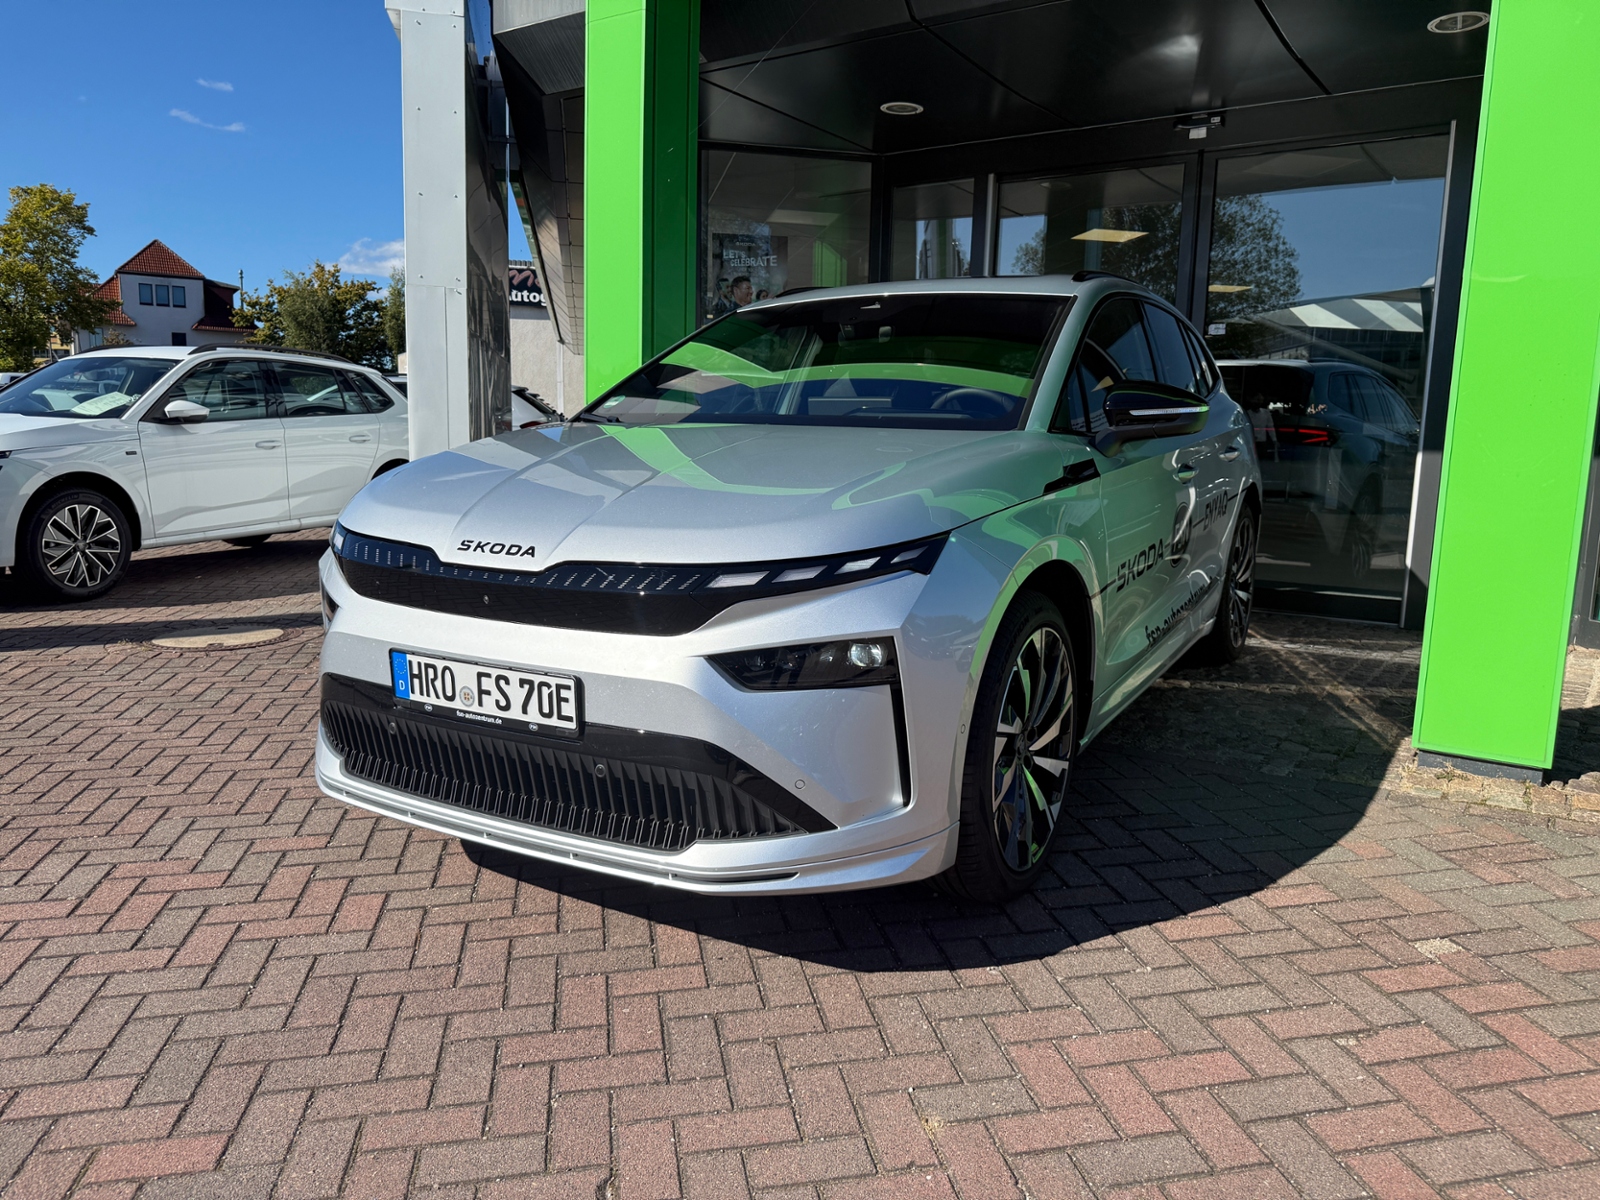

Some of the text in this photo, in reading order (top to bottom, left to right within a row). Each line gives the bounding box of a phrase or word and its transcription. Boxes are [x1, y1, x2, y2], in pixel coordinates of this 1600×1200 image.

[723, 249, 746, 259] LET'S
[730, 255, 778, 267] CELEBRATE
[509, 289, 547, 306] utog
[457, 539, 536, 558] SKODA
[1116, 538, 1165, 593] SKODA
[1203, 490, 1228, 531] ENYAQ
[398, 659, 574, 723] D HRO FS 70E
